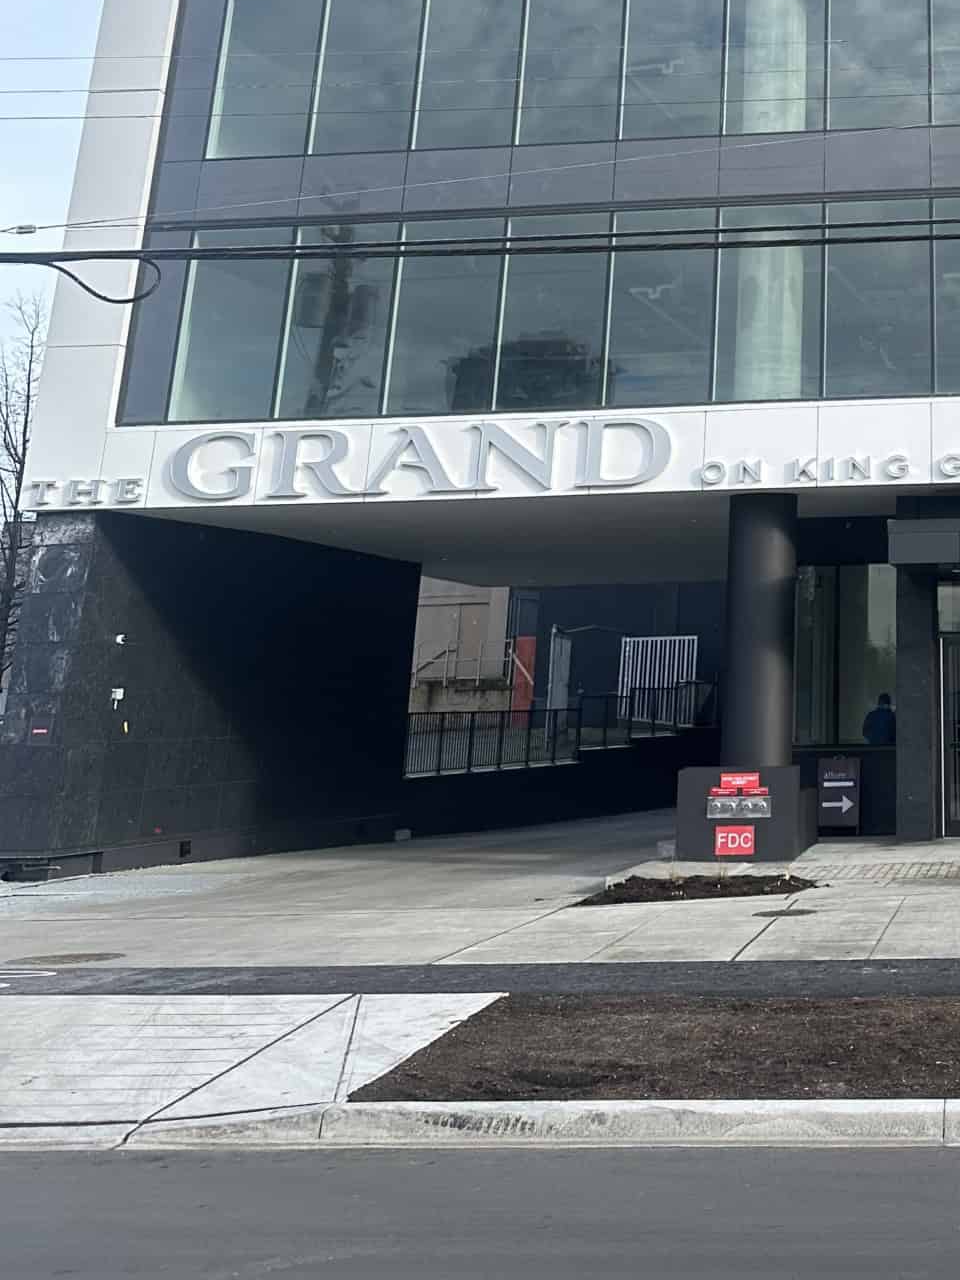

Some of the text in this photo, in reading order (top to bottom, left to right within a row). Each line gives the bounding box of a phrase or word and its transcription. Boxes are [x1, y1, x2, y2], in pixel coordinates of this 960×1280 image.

[30, 478, 143, 505] THE
[166, 416, 673, 501] GRAND
[697, 459, 764, 485] ON
[791, 454, 911, 483] KING
[718, 832, 752, 848] FDC
